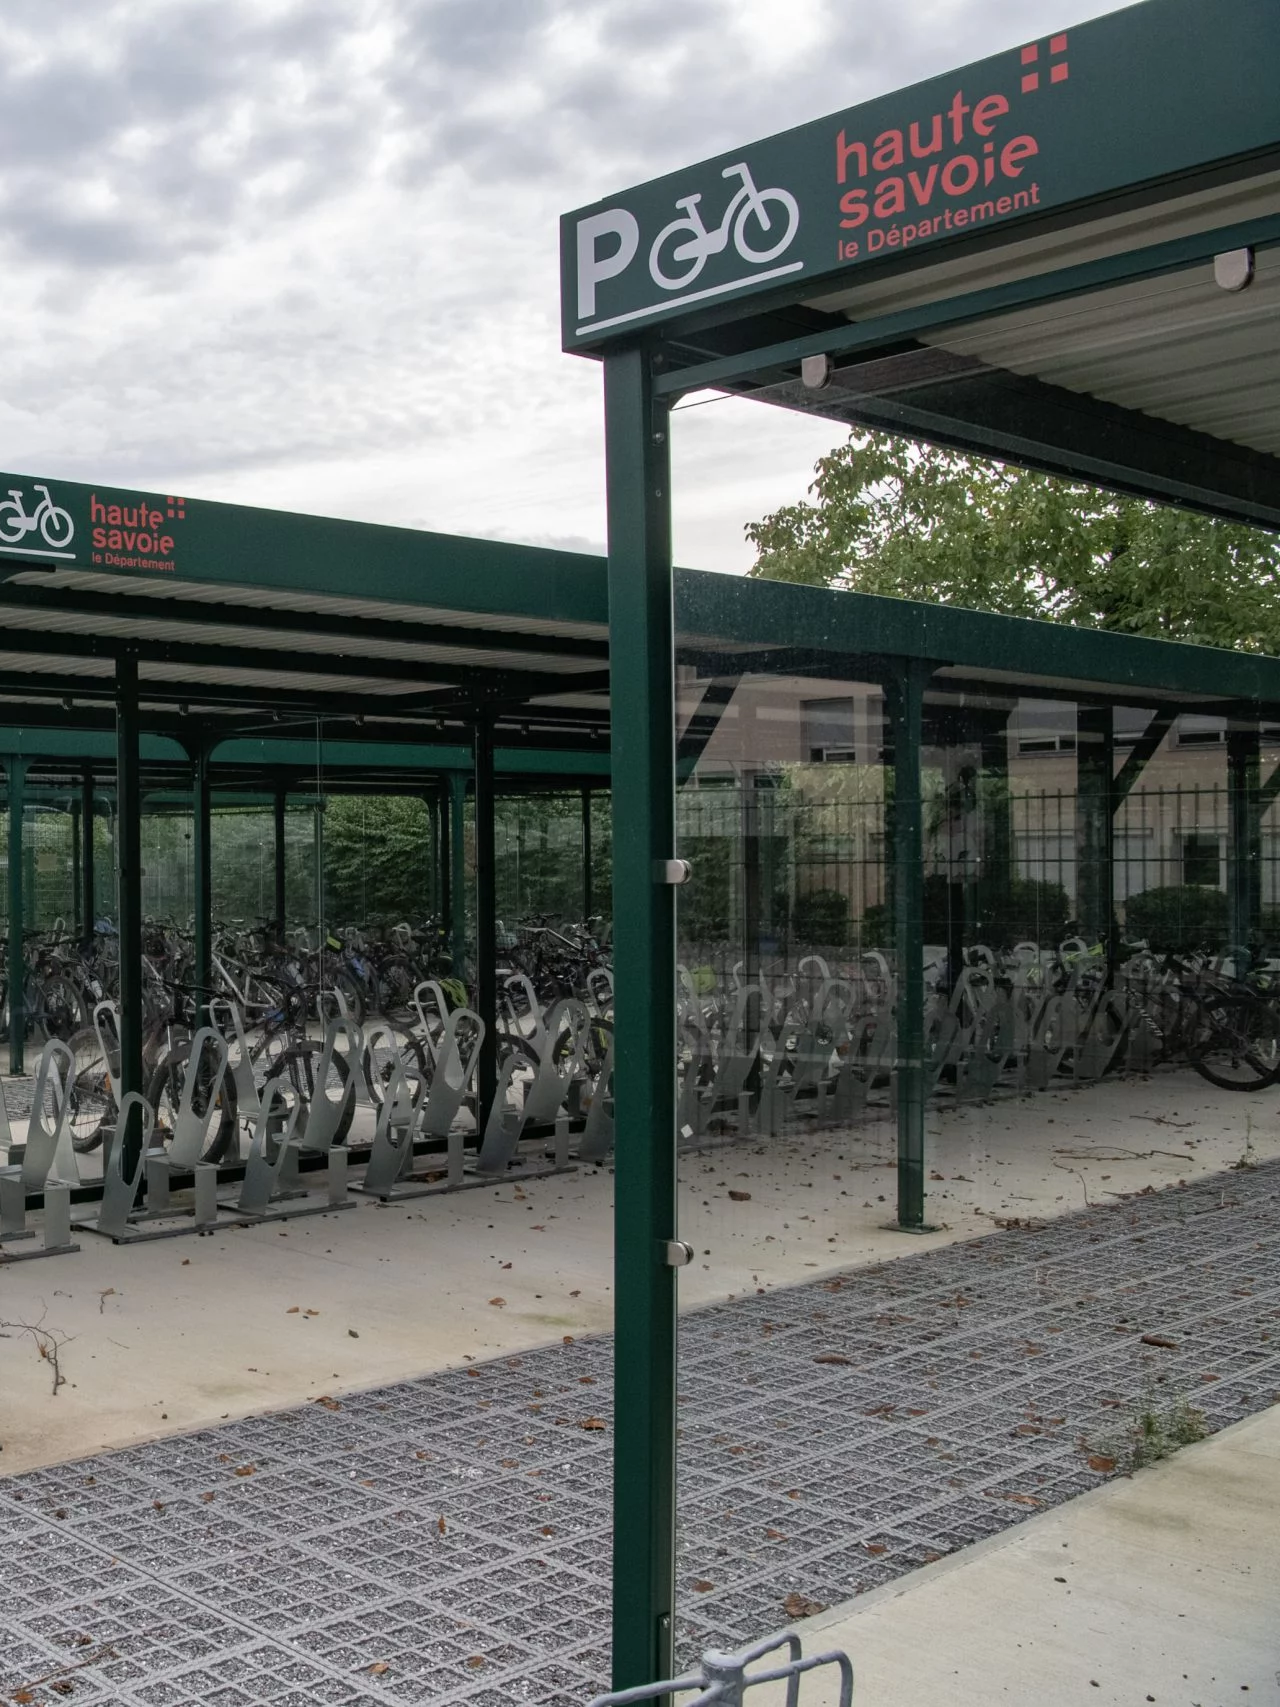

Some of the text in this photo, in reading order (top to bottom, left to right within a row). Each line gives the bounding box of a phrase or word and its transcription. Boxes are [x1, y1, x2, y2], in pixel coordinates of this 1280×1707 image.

[837, 90, 1009, 184] haute
[839, 135, 1039, 229] savoie
[838, 183, 1041, 261] le Département
[577, 208, 639, 320] P
[91, 493, 164, 529] haute
[92, 525, 175, 555] savoie
[92, 552, 175, 571] le Département
